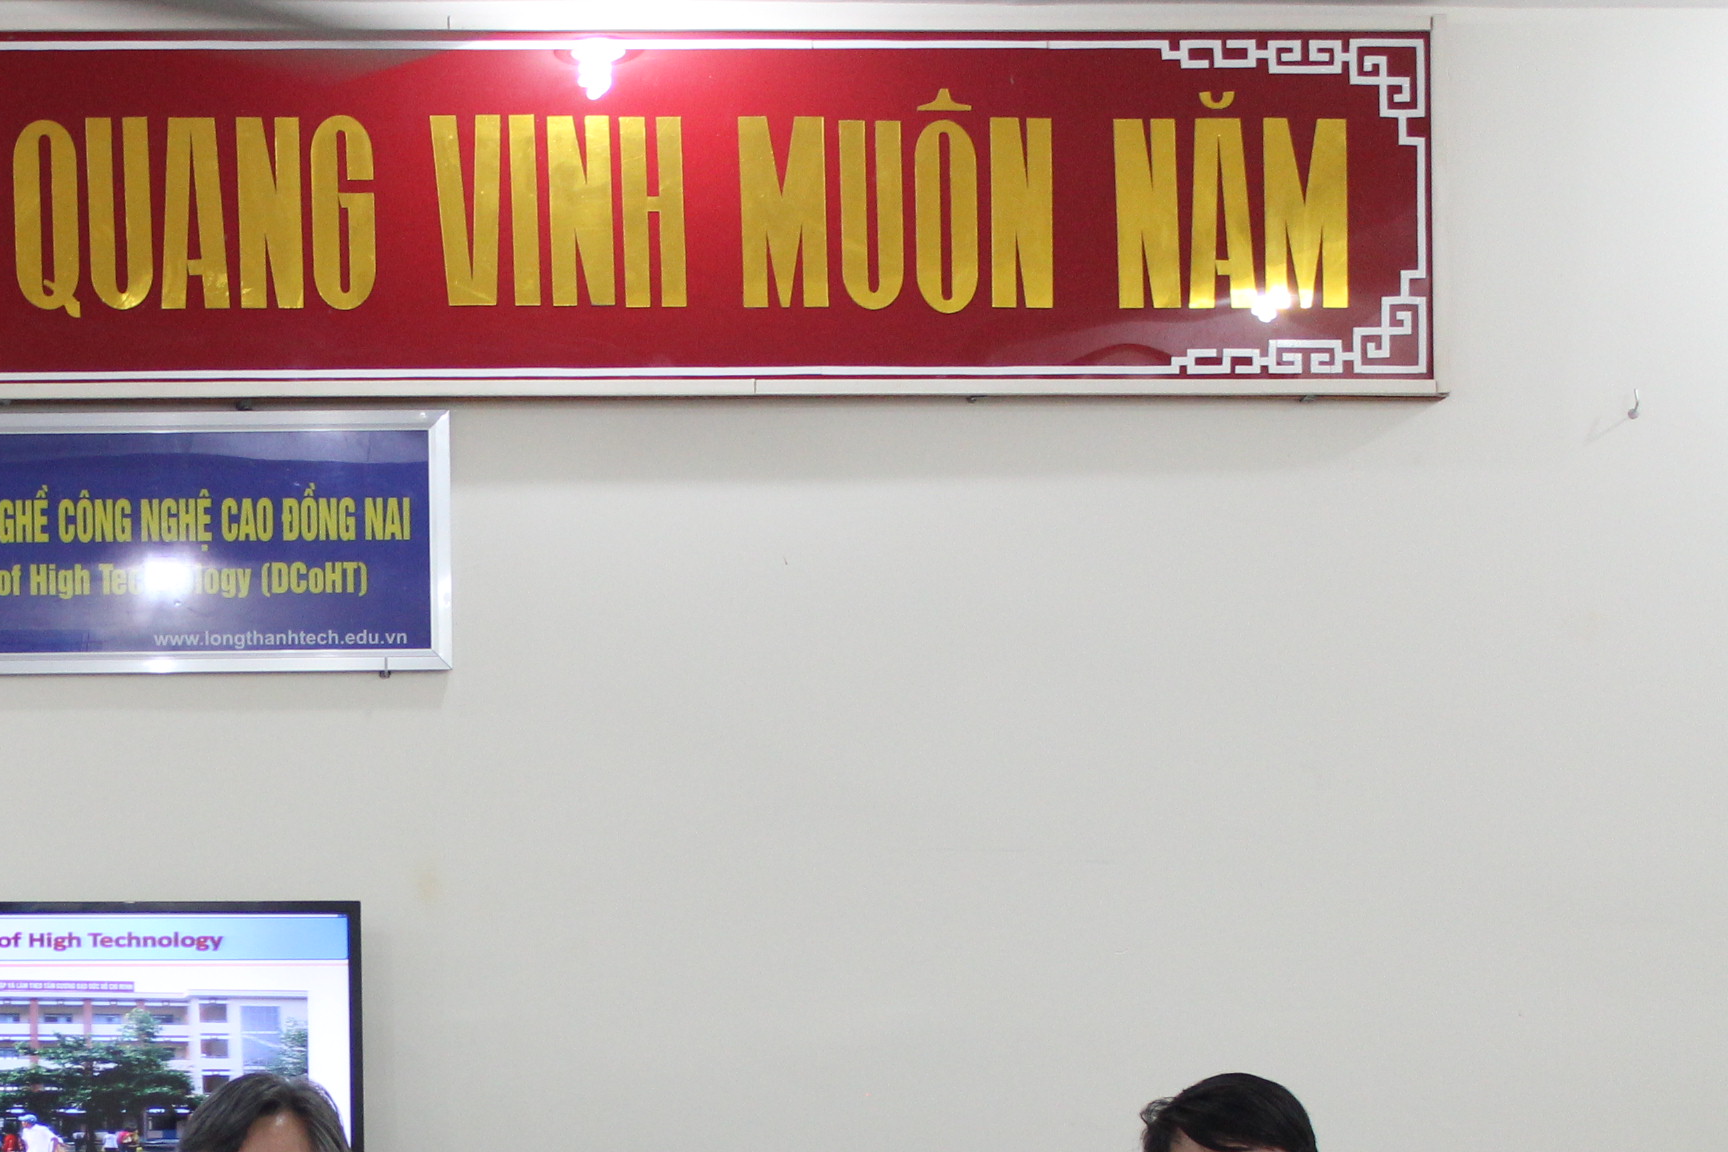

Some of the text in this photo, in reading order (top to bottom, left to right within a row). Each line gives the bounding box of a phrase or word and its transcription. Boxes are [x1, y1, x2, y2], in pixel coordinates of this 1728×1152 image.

[12, 115, 376, 319] QUANG
[428, 114, 688, 308] VINH
[737, 87, 1055, 315] MUÔN
[1111, 89, 1350, 311] NĂM
[58, 489, 132, 543] CÔNG
[140, 488, 213, 552] NGHỆ
[221, 497, 274, 542] CAO
[281, 482, 356, 542] ĐỒNG
[364, 497, 411, 541] NAI
[30, 563, 91, 600] High
[98, 562, 252, 598] Teclogy
[261, 561, 368, 597] (DCoHT)
[153, 629, 408, 649] www.longthanhtech.edu.vn
[28, 932, 82, 952] High
[87, 931, 225, 952] Technology
